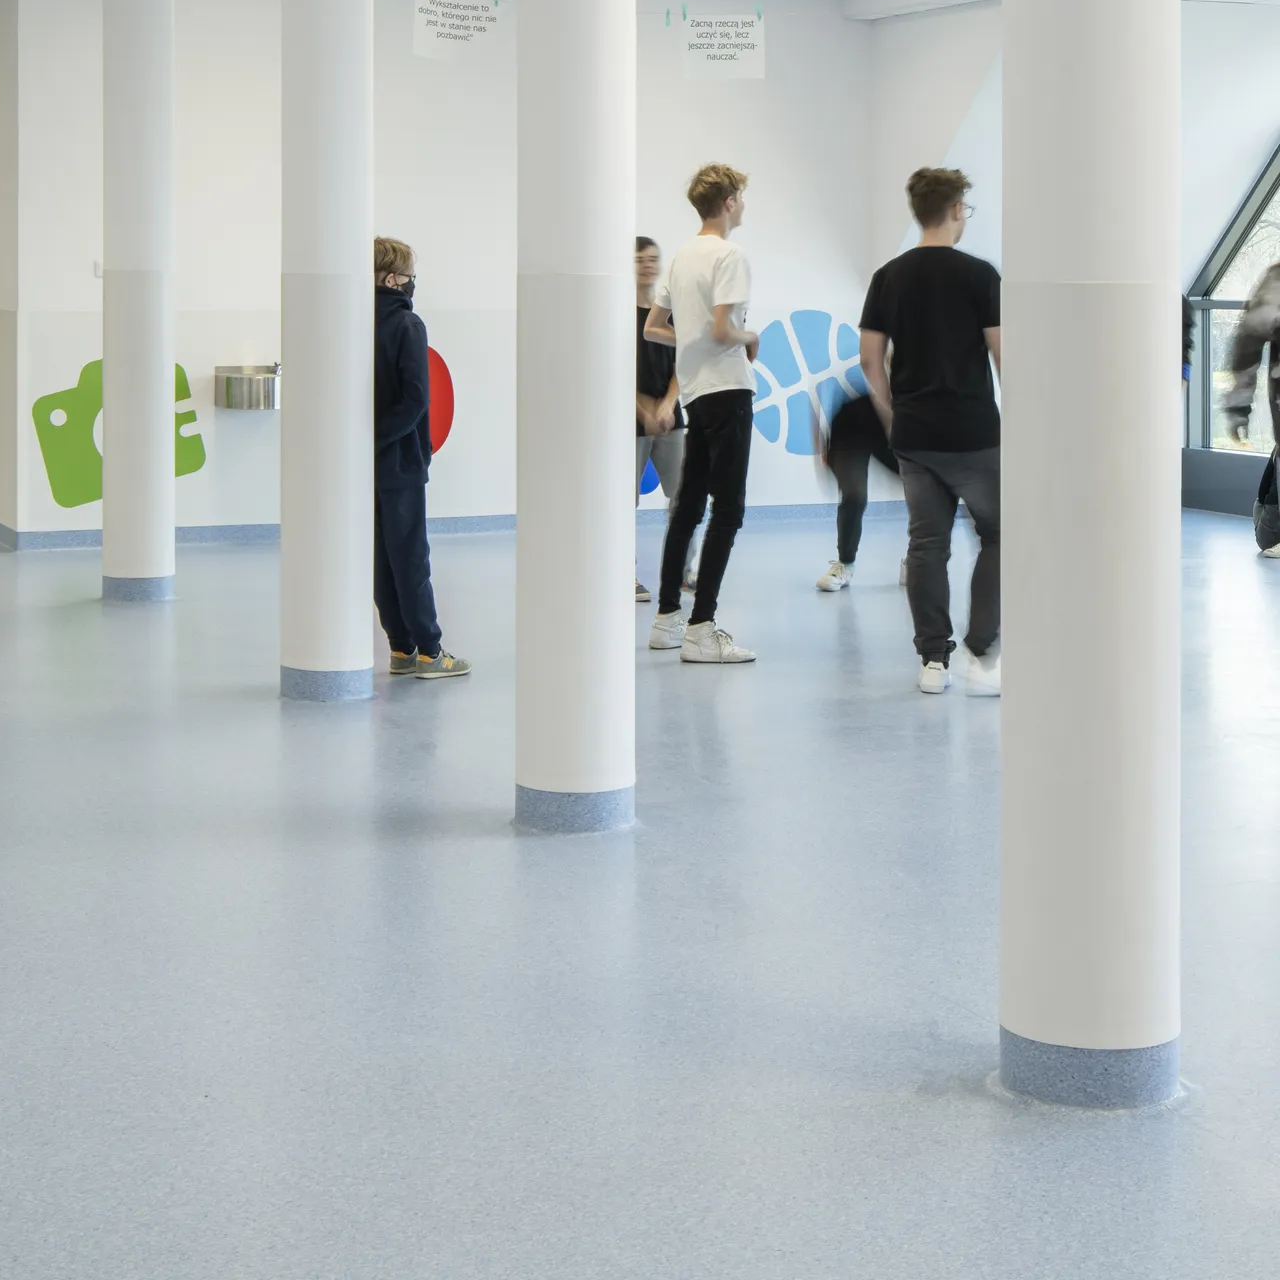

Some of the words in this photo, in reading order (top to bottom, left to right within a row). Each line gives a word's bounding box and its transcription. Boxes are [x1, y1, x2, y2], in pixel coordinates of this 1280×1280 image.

[418, 6, 439, 18] dobro,
[441, 11, 469, 22] którego
[426, 19, 438, 27] jest
[448, 23, 471, 31] stanie
[690, 20, 713, 29] Zacną
[715, 20, 739, 29] rzeczą
[741, 20, 755, 29] jest
[696, 30, 717, 40] uczyć
[719, 31, 732, 40] się,
[735, 31, 749, 39] lecz
[688, 42, 715, 51] jeszcze
[717, 41, 758, 51] zacniejszą-
[706, 52, 739, 61] nauczać.
